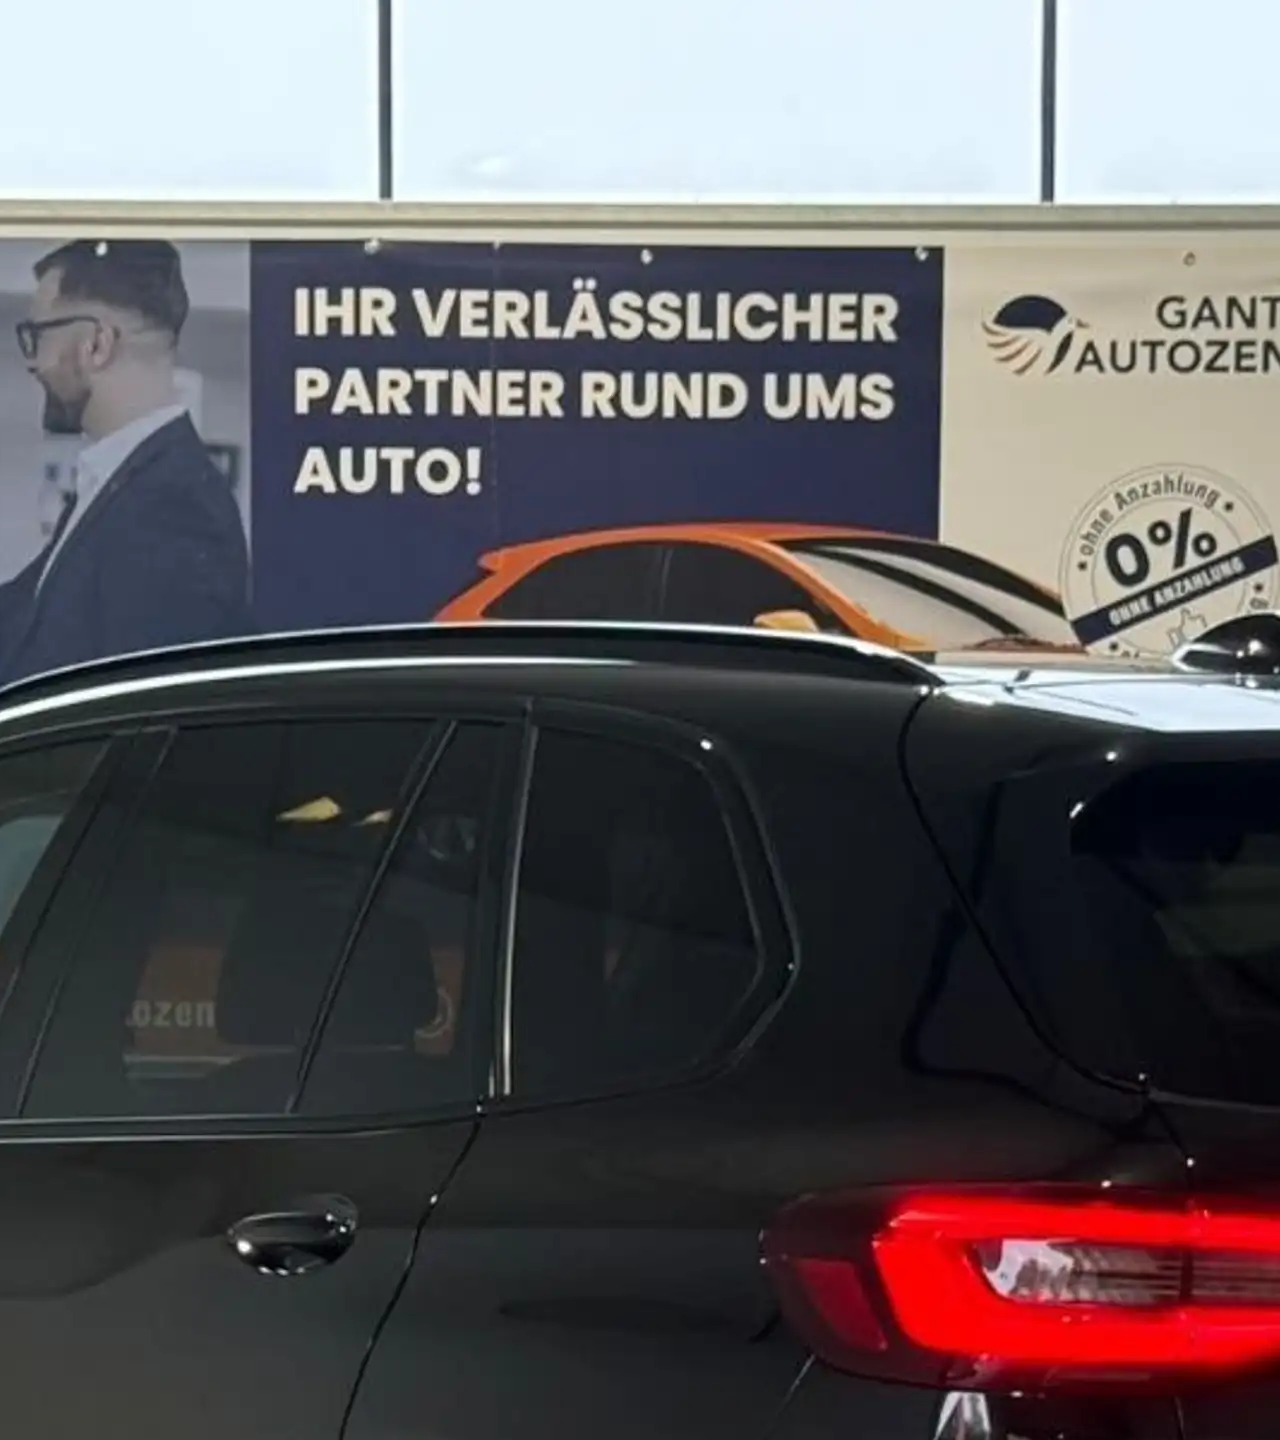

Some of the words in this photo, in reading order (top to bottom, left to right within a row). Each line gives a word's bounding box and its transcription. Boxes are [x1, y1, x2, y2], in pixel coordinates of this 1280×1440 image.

[294, 286, 396, 338] IHR
[411, 278, 899, 343] VERLÄSSLICHER
[294, 367, 564, 419] PARTNER
[580, 370, 749, 420] RUND
[763, 372, 896, 422] UMS
[293, 446, 483, 496] AUTO!
[1079, 508, 1116, 558] ohne
[1112, 472, 1221, 510] Anzahlung
[1104, 507, 1218, 588] 0%
[1107, 596, 1153, 627] OHNE
[1153, 556, 1247, 607] ANZAHLUNG
